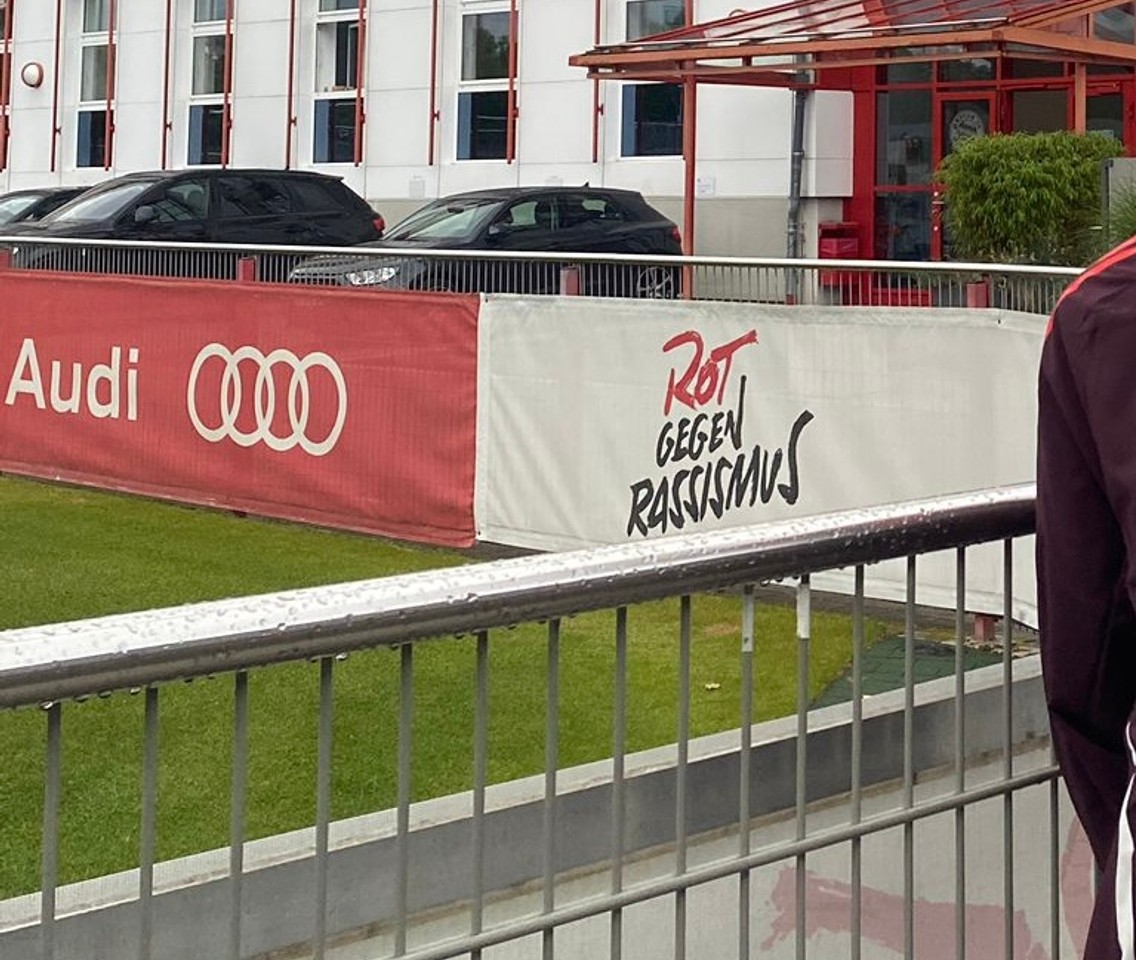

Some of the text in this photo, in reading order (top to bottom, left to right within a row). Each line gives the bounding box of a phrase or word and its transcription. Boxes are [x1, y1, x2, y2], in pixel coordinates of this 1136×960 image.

[4, 338, 139, 421] Audi
[662, 330, 759, 416] ROT
[656, 375, 747, 468] GEGEN
[627, 410, 815, 537] RASSISMUS
